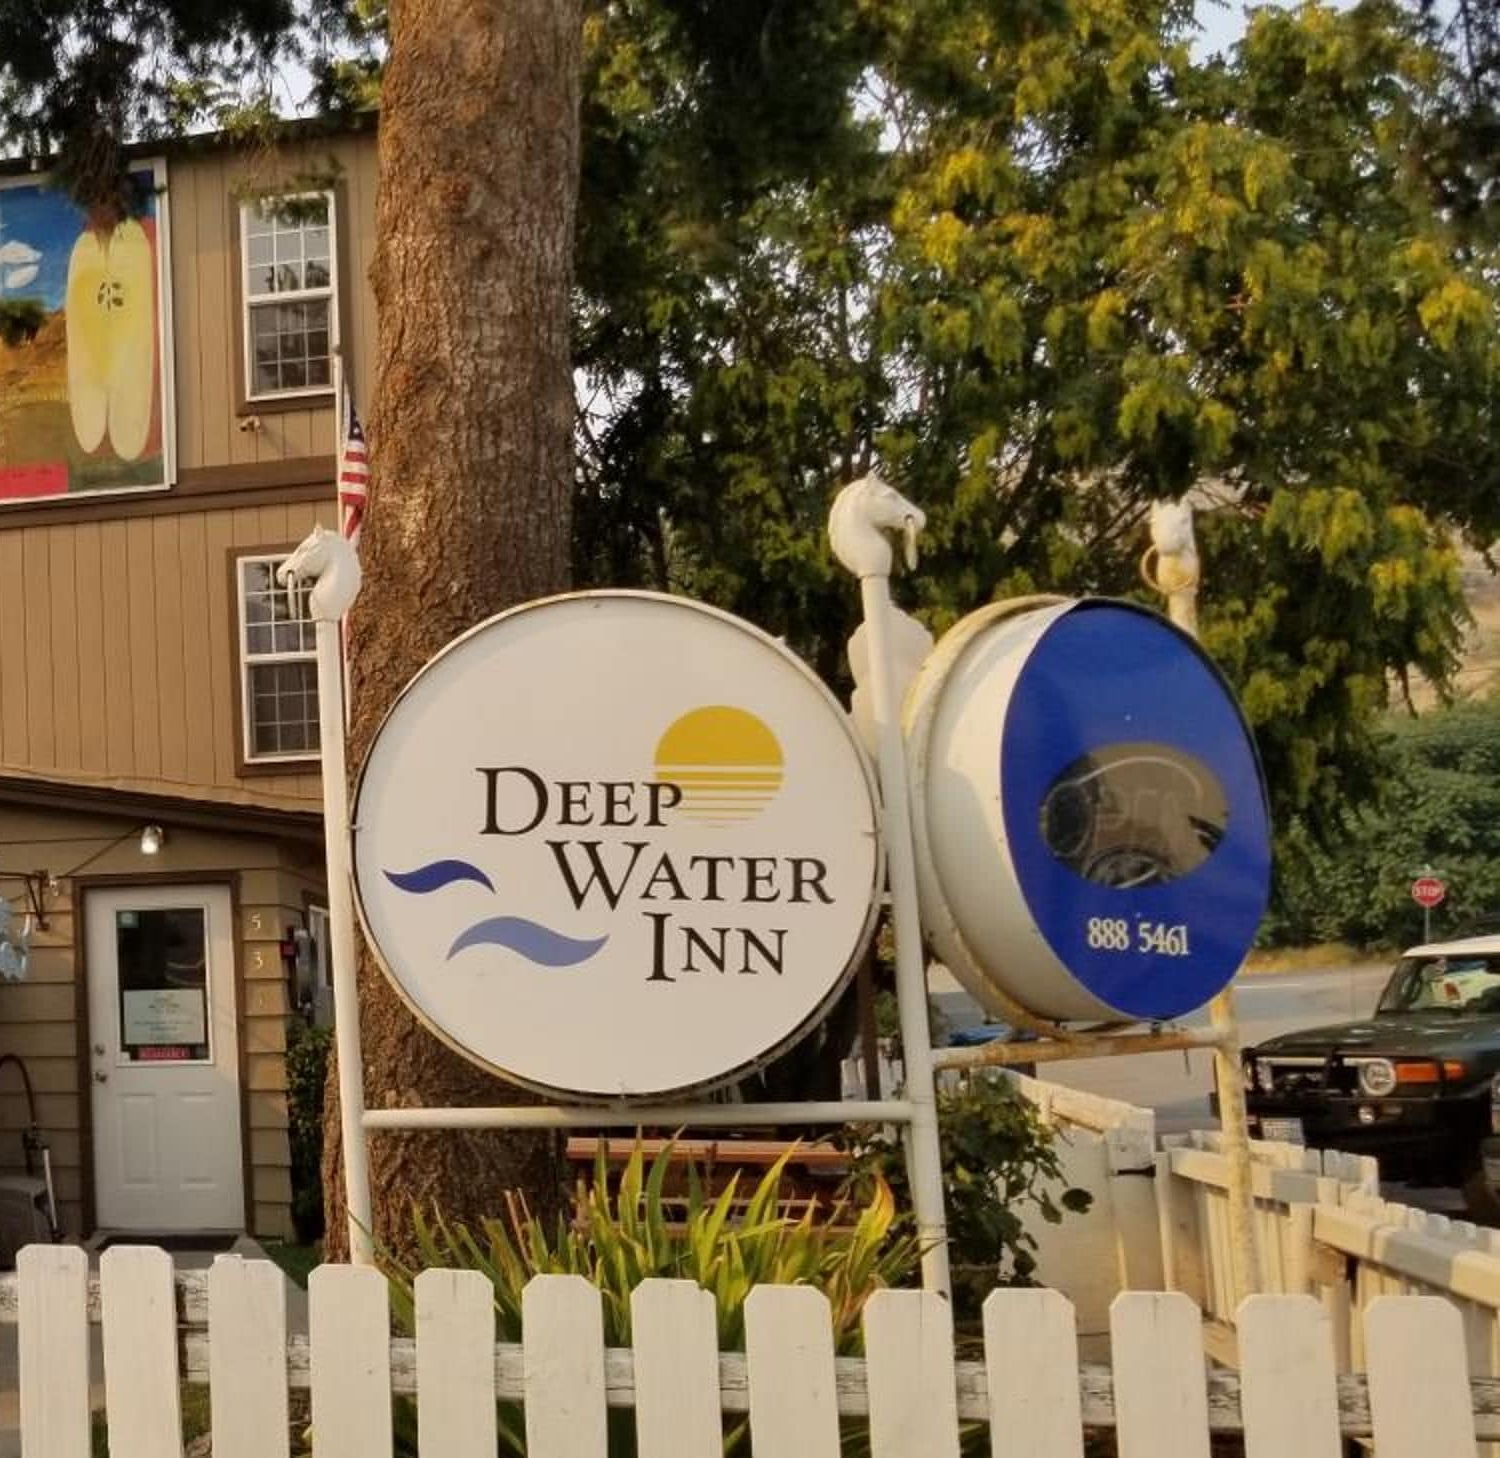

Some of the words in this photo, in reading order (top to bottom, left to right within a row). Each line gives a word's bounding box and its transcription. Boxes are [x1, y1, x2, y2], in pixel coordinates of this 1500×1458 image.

[475, 766, 683, 836] DEEP
[545, 840, 836, 912] WATER
[1413, 886, 1442, 898] STOP
[642, 911, 789, 983] INN
[1087, 917, 1130, 951] 888
[1138, 921, 1191, 957] 5461
